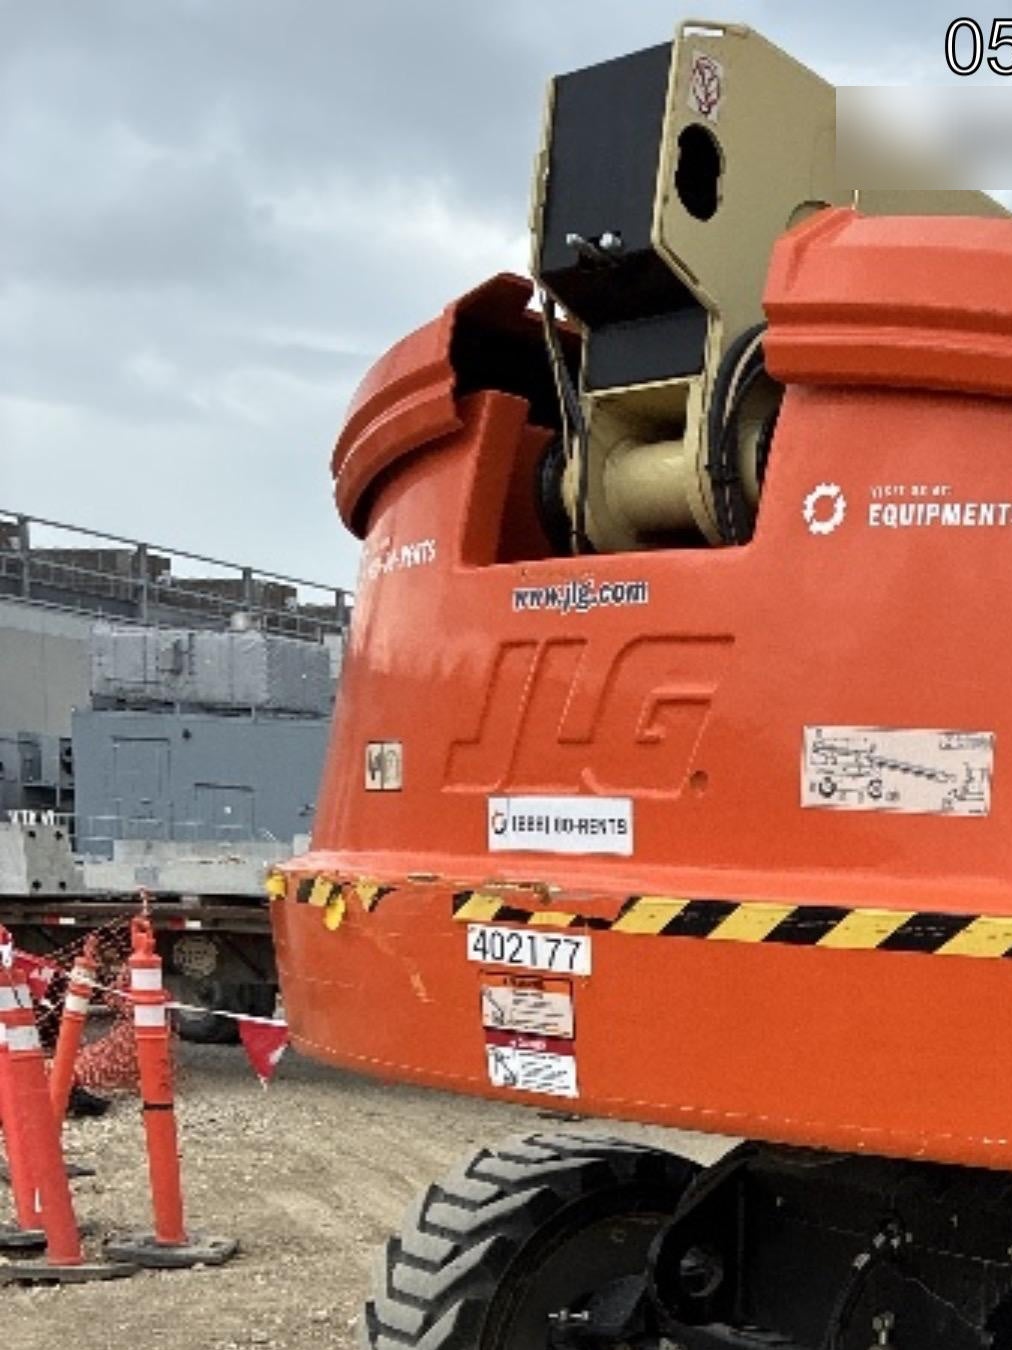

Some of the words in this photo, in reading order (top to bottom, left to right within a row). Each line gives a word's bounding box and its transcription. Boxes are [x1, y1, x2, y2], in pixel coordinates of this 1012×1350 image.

[513, 579, 648, 615] www.jlg.com
[441, 634, 736, 800] JLG
[472, 930, 584, 971] 402177
